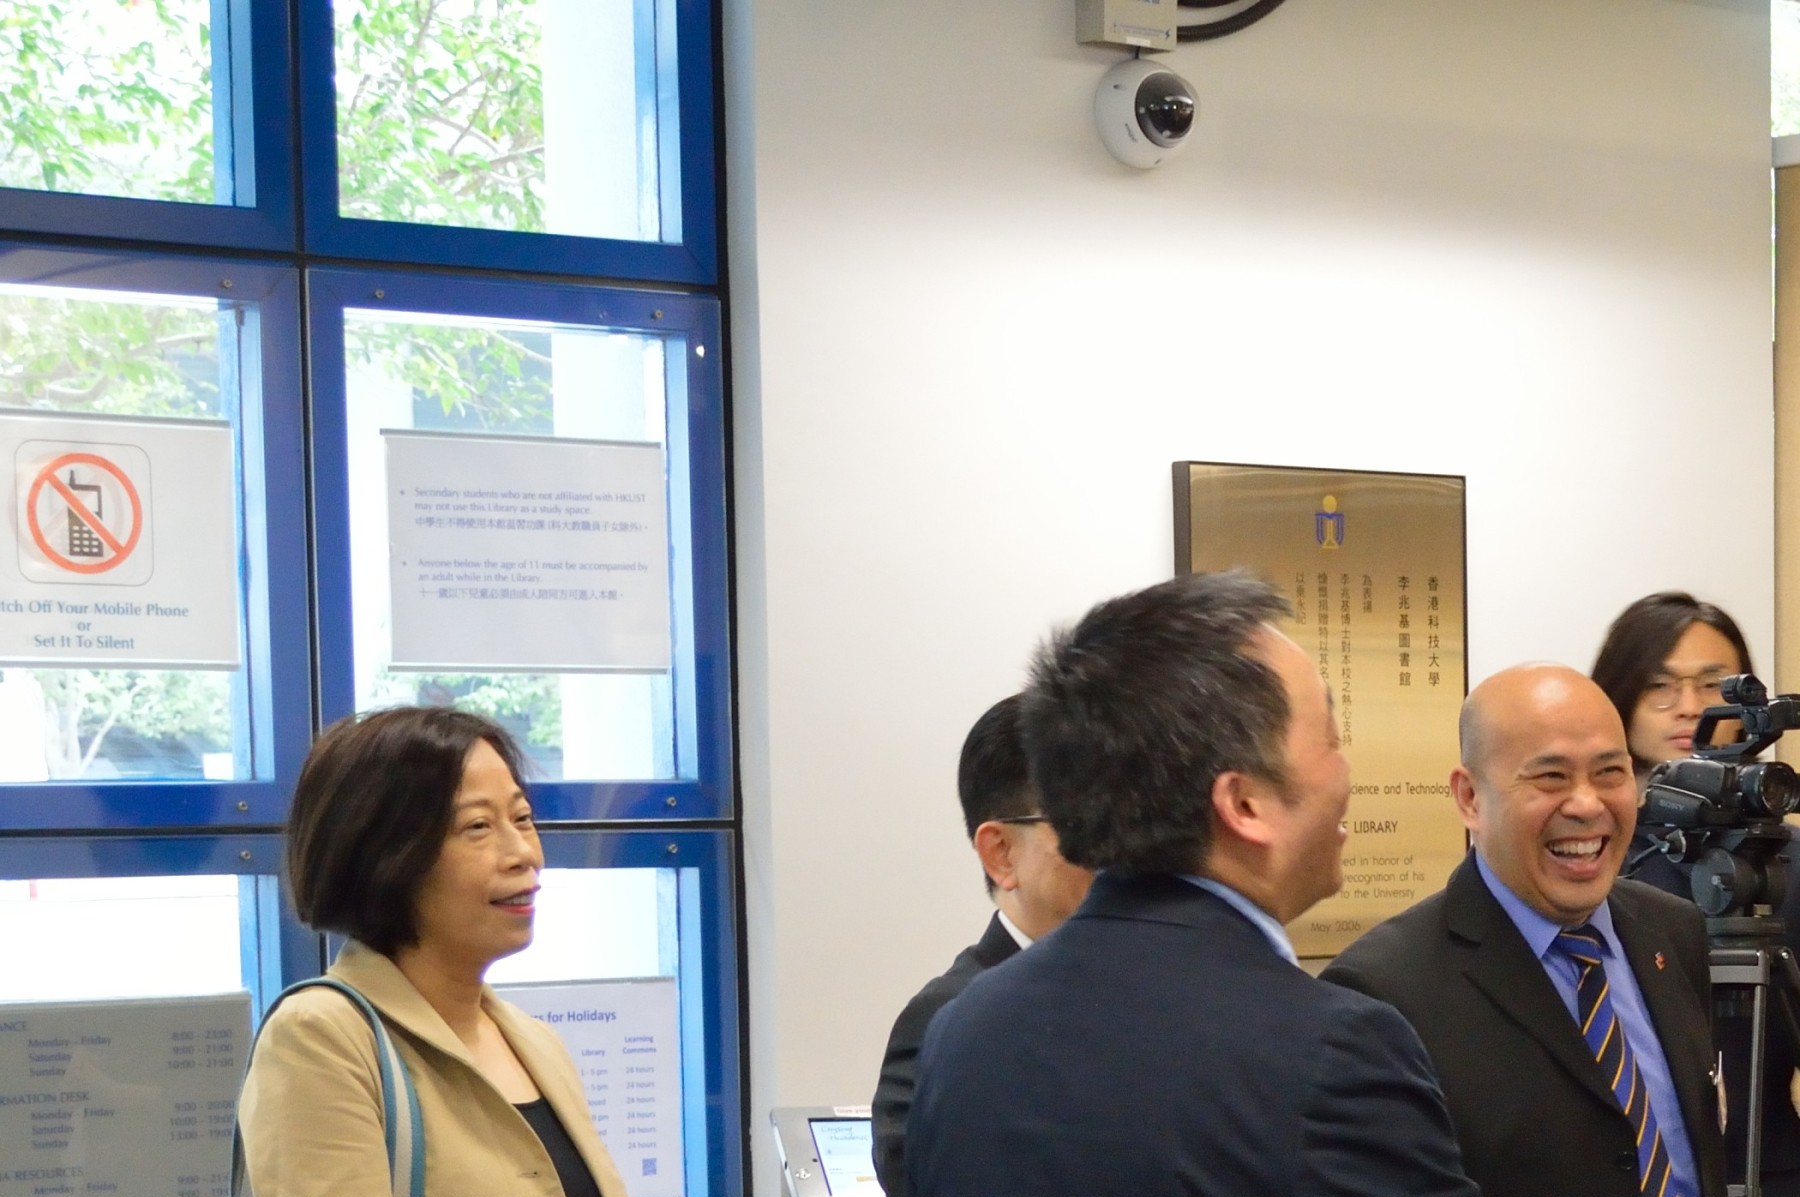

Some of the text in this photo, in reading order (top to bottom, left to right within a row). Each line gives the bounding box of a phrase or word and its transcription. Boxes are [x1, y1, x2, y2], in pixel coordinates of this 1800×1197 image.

[414, 487, 646, 504] Secondary students who are not affiliated with HKUST
[414, 503, 432, 513] may
[435, 502, 450, 511] not
[452, 504, 468, 512] use
[469, 502, 486, 513] this
[488, 503, 518, 515] Library
[520, 506, 532, 514] as
[539, 504, 562, 516] study
[418, 559, 649, 574] Anyone below the age of 11 must be accompanied by
[418, 574, 430, 582] an
[431, 571, 454, 582] adult
[456, 572, 482, 582] while
[483, 573, 493, 582] in
[494, 572, 509, 582] the
[29, 600, 53, 614] Off
[57, 601, 89, 615] Your
[94, 603, 141, 617] Mobile
[147, 604, 190, 618] Phone
[77, 622, 92, 633] or
[1397, 575, 1411, 686] 李兆基圖書館
[1427, 575, 1440, 687] 香港科技大學
[34, 635, 135, 650] Set It To Silent
[1348, 781, 1379, 795] cience
[1384, 782, 1401, 795] and
[1354, 820, 1398, 834] LIBRARY
[1360, 855, 1369, 866] in
[1373, 855, 1399, 866] honor
[1404, 854, 1414, 866] of
[1400, 871, 1409, 882] of
[1413, 871, 1425, 882] his
[1354, 887, 1370, 899] the
[1373, 887, 1416, 899] University
[1310, 920, 1361, 934] May 2006
[547, 1010, 565, 1024] for
[567, 1009, 617, 1023] Holidays
[28, 1038, 69, 1048] Monday
[81, 1036, 111, 1047] Friday
[625, 1035, 654, 1044] Learning
[29, 1052, 72, 1063] Saturday
[582, 1046, 657, 1058] Library Commons
[29, 1066, 67, 1077] Sunday
[60, 1090, 91, 1103] DESK
[31, 1109, 73, 1120] Monday
[84, 1107, 115, 1118] Friday
[15, 1166, 84, 1181] RESOURCES
